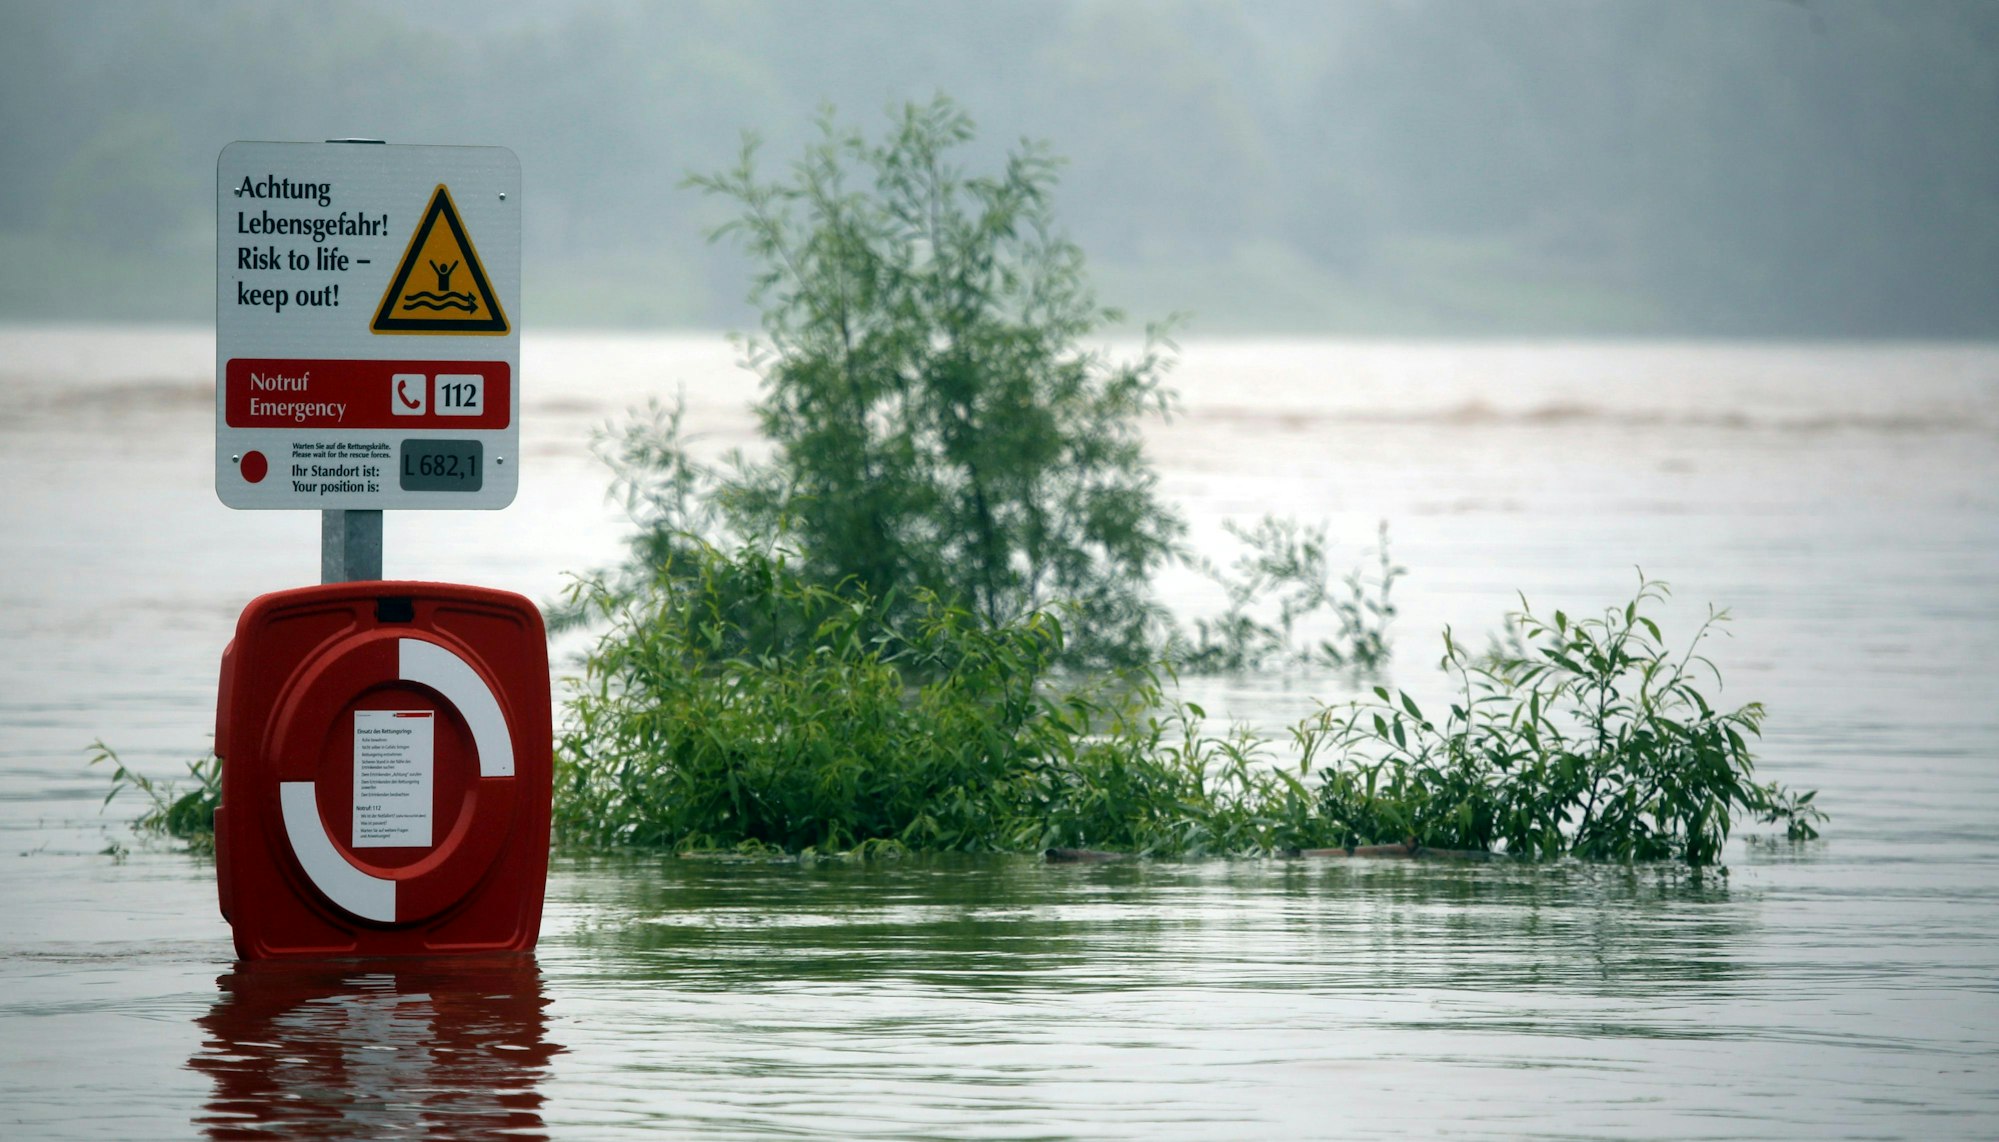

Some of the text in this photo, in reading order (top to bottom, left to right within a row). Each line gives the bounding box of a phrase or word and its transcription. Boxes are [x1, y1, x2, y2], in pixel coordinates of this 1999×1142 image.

[239, 174, 331, 207] Achtung
[238, 210, 388, 242] Lebensgefahr!
[238, 246, 281, 270] Risk
[288, 250, 309, 270] to
[317, 247, 349, 271] life
[238, 281, 339, 313] keep out!
[250, 371, 310, 391] Notruf
[441, 383, 477, 407] 112
[250, 397, 346, 423] Emergency
[347, 442, 391, 452] Rettungskräfte.
[292, 464, 380, 477] Ihr Standort ist:
[404, 454, 476, 480] L 682,1
[292, 480, 380, 496] Your position is:
